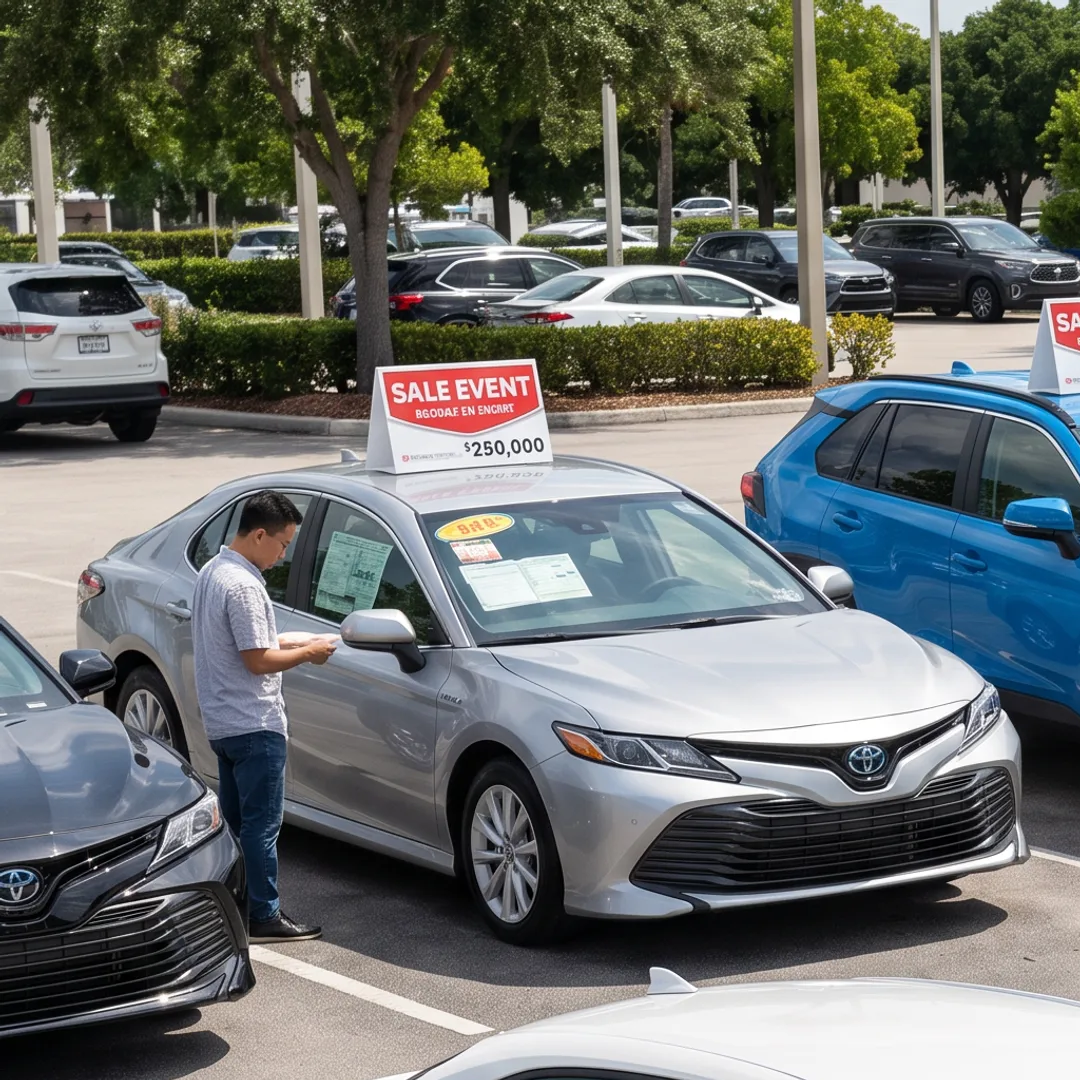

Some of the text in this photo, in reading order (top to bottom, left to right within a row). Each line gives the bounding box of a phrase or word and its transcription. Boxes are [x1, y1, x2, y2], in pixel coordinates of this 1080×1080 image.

[391, 375, 530, 404] SALE EVENT
[462, 407, 475, 417] EN
[464, 437, 545, 459] $250,000
